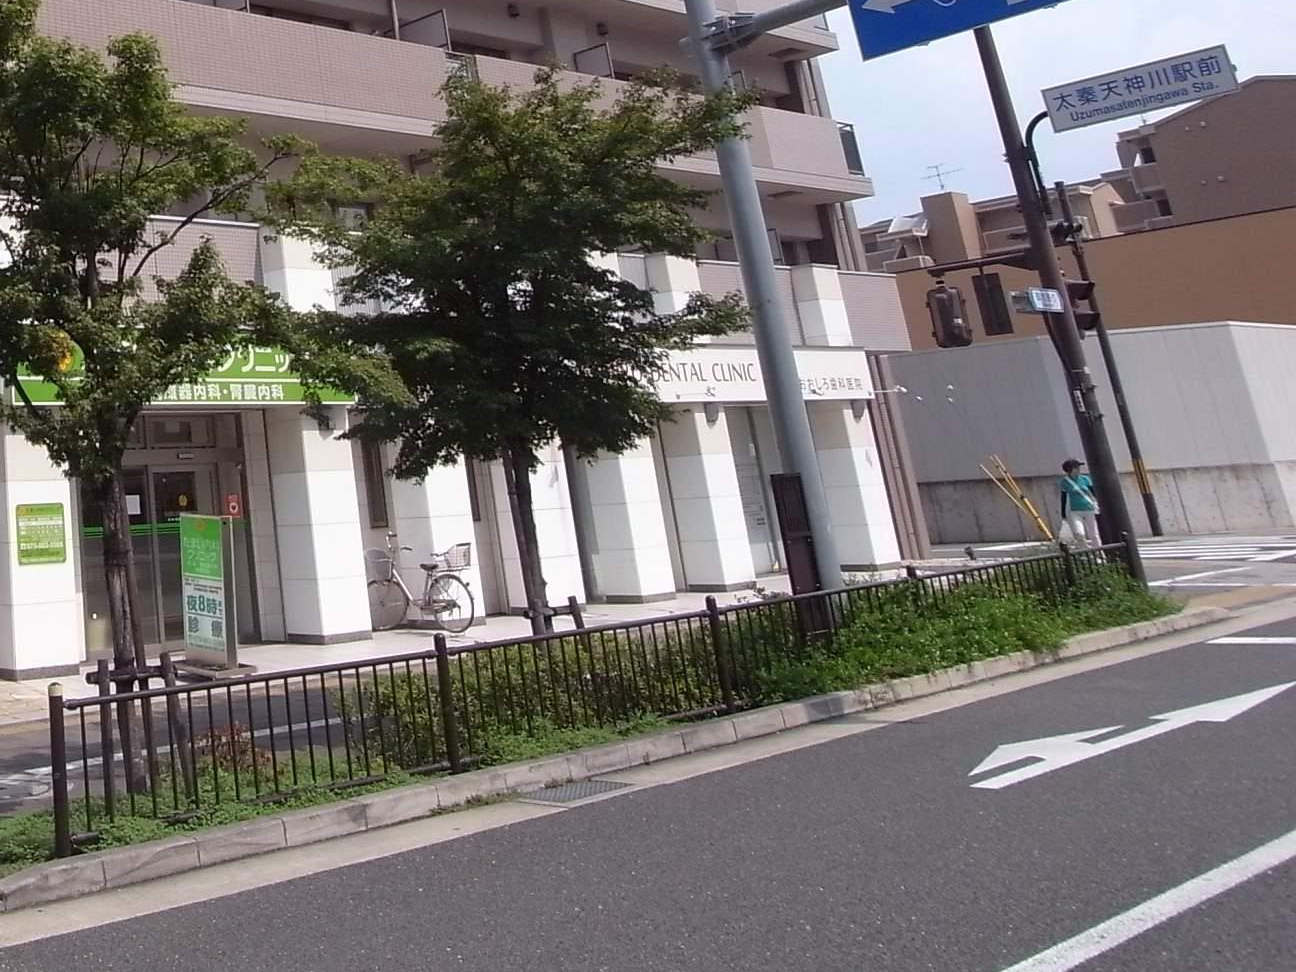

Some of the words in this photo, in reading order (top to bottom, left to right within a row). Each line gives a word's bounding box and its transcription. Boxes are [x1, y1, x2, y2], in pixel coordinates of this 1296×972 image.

[1052, 55, 1222, 112] 太秦天神川駅前
[1069, 88, 1188, 122] Uzumasatenjingawa
[1193, 80, 1219, 94] Sta.
[652, 362, 707, 383] DENTAL
[712, 363, 757, 383] CLINIC
